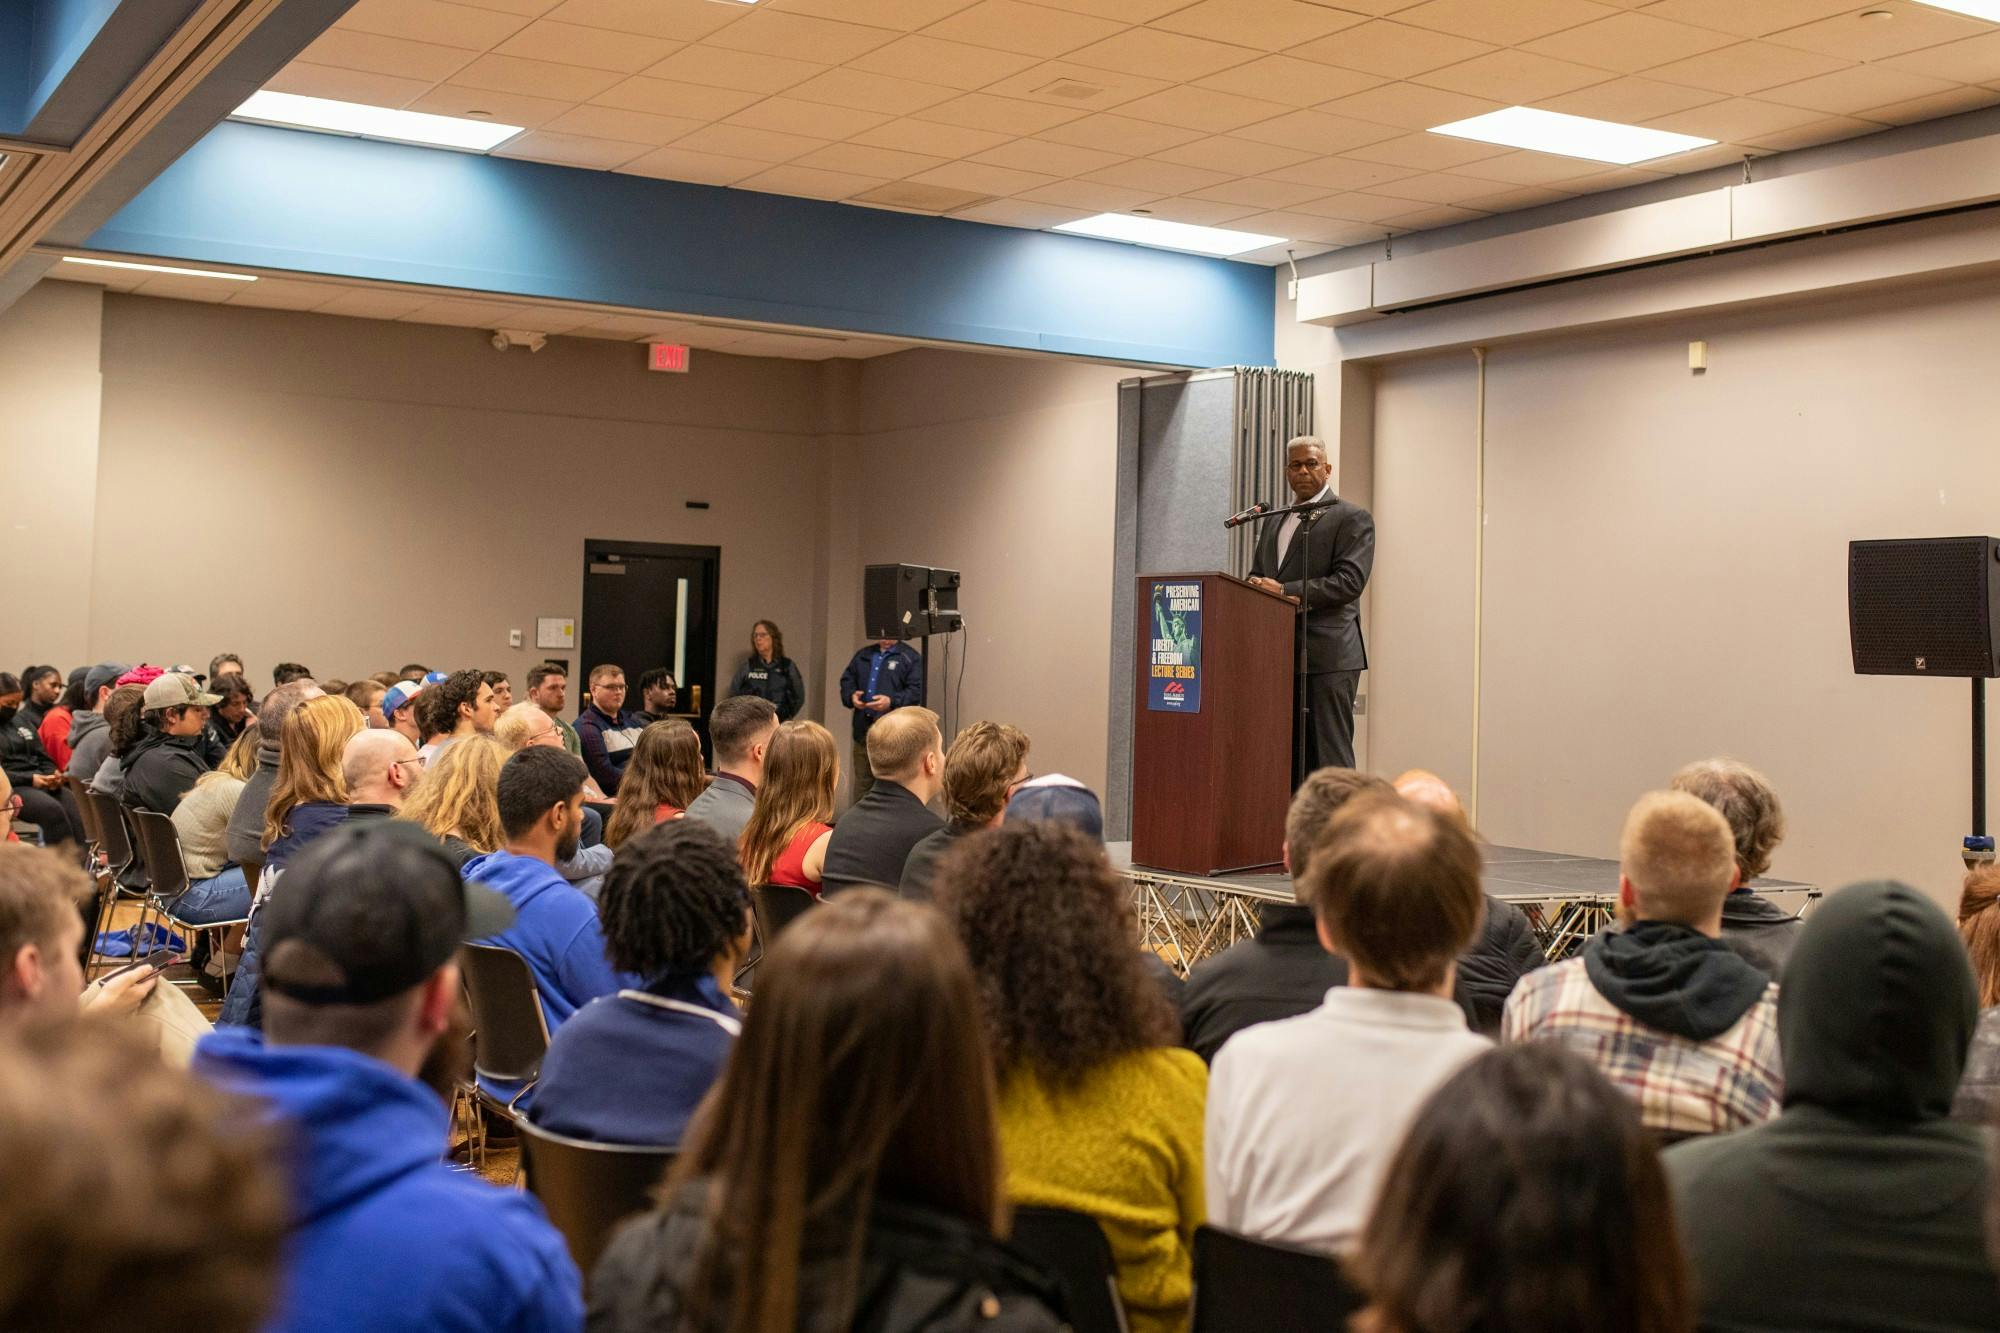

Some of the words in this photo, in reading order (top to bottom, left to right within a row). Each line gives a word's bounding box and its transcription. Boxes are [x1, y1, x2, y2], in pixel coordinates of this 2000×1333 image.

[655, 345, 685, 369] EXIT
[1166, 585, 1199, 598] PRESERVING
[1170, 598, 1199, 611] AMERICAN
[1152, 639, 1173, 651] LIBERTY
[1152, 652, 1156, 664] &
[1157, 652, 1183, 665] FREEDOM
[1152, 665, 1175, 678] LECTURE
[1176, 666, 1195, 679] SERIES
